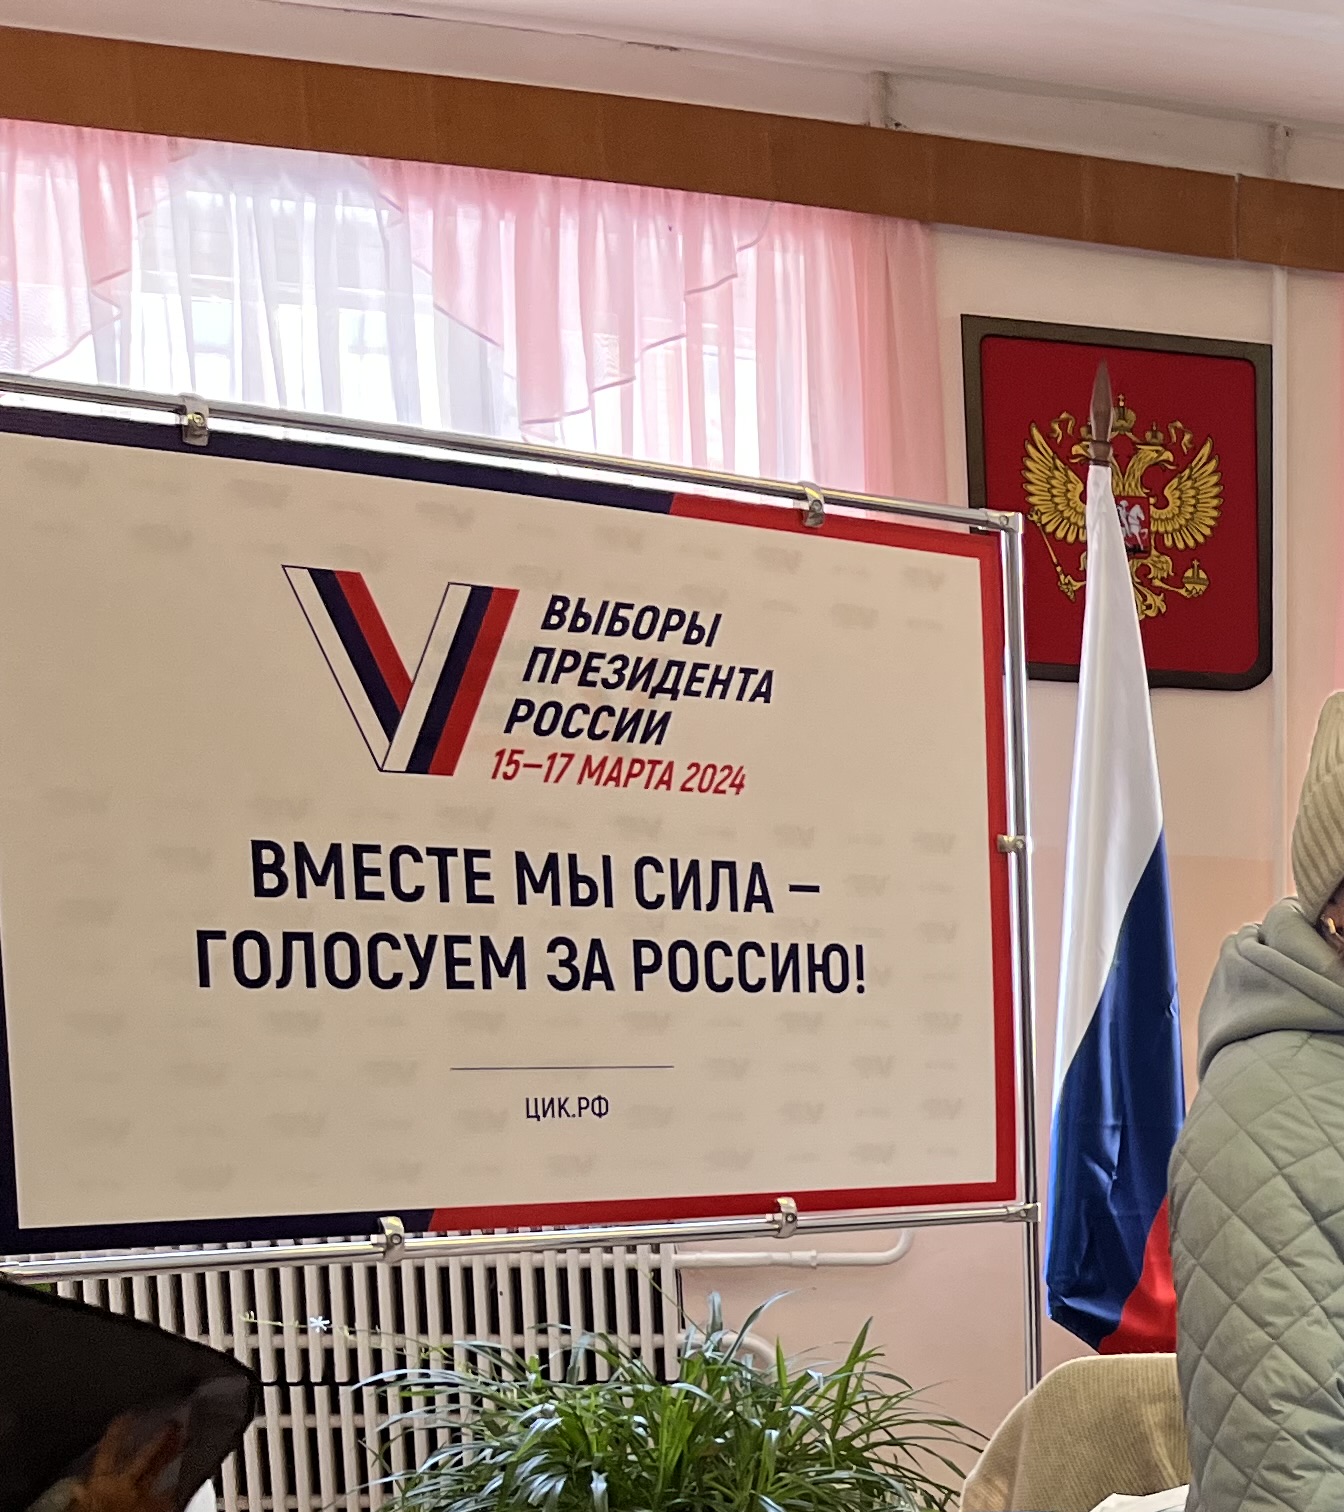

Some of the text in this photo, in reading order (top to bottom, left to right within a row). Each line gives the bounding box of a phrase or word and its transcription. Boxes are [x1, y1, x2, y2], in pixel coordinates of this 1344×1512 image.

[540, 594, 723, 648] ВЫБОРЫ
[521, 645, 775, 704] ПРЕЗИДЕНТА
[503, 697, 673, 746] РОССИИ
[576, 754, 675, 791] МАРТА
[679, 762, 746, 796] 2024
[250, 839, 495, 905] ВМЕСТЕ
[514, 850, 614, 909] МЫ
[634, 855, 776, 914] СИЛА
[195, 929, 866, 994] ГОЛОСУЕМ ЗА РОССИЮ!
[525, 1094, 609, 1122] ЦИК.РФ
